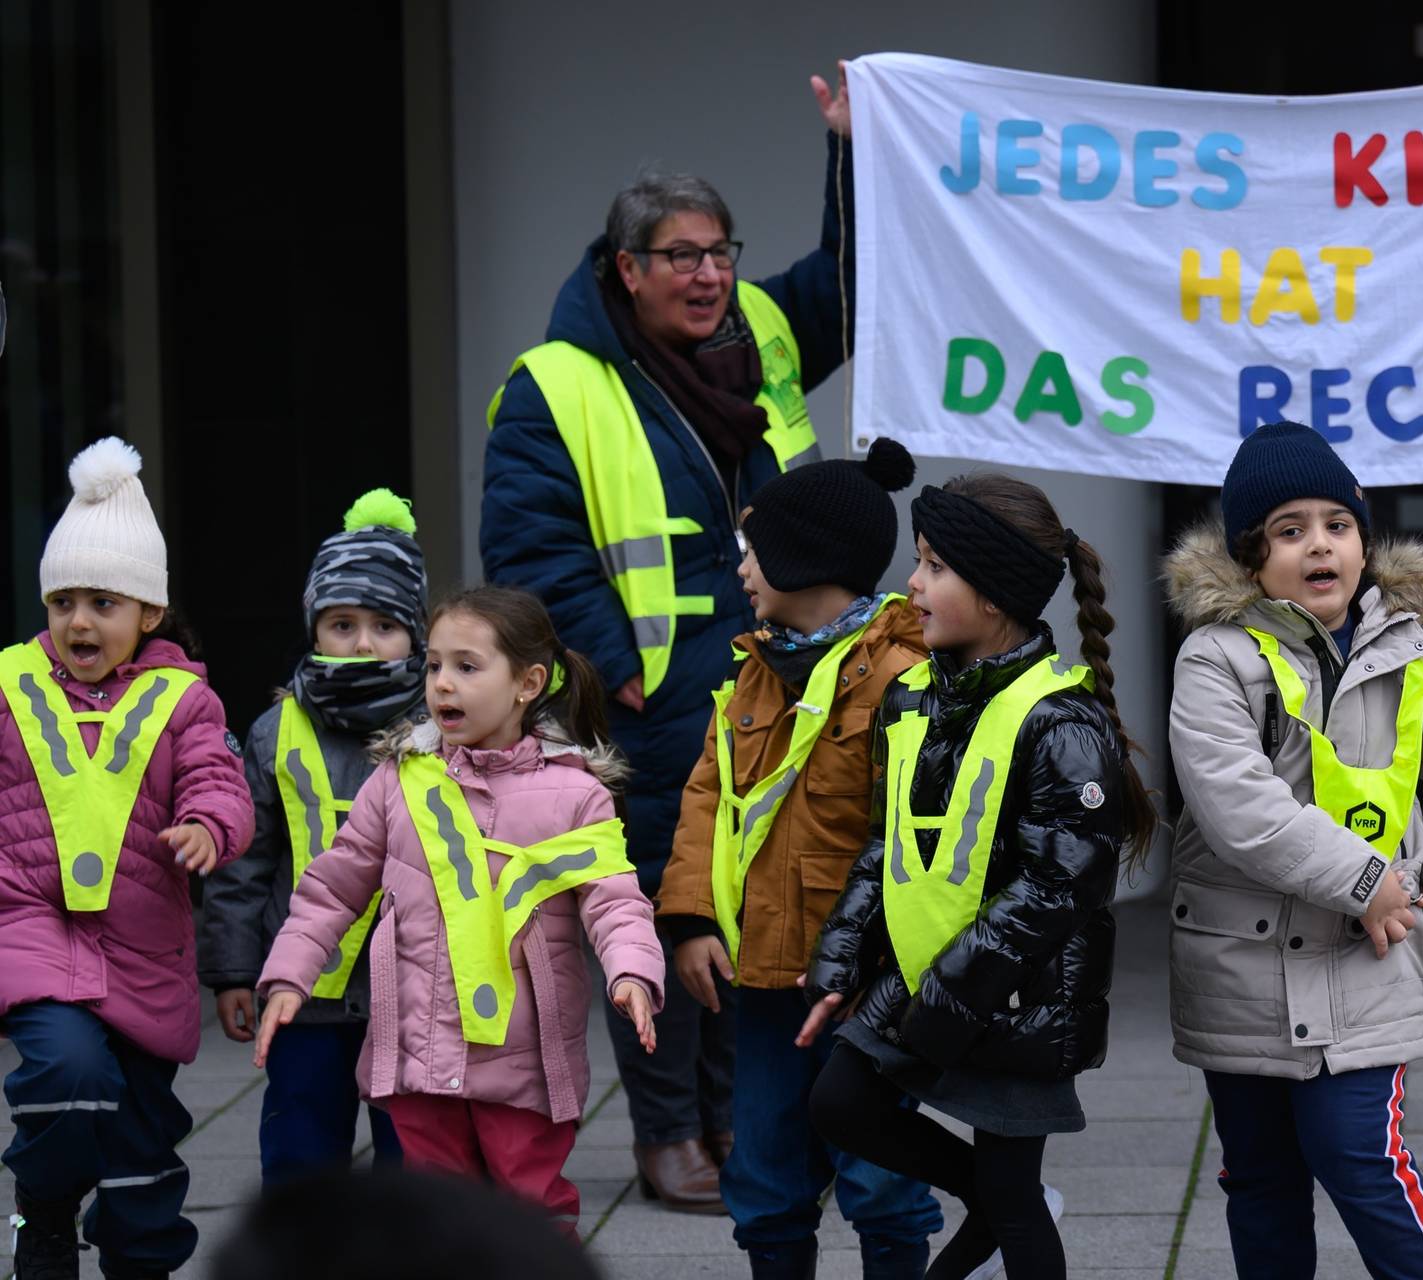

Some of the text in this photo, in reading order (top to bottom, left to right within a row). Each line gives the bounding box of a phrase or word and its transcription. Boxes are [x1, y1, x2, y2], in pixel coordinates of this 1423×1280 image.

[940, 111, 1249, 211] JEDES
[1180, 246, 1373, 326] HAT
[942, 337, 1155, 436] DAS
[1354, 818, 1377, 829] VRR
